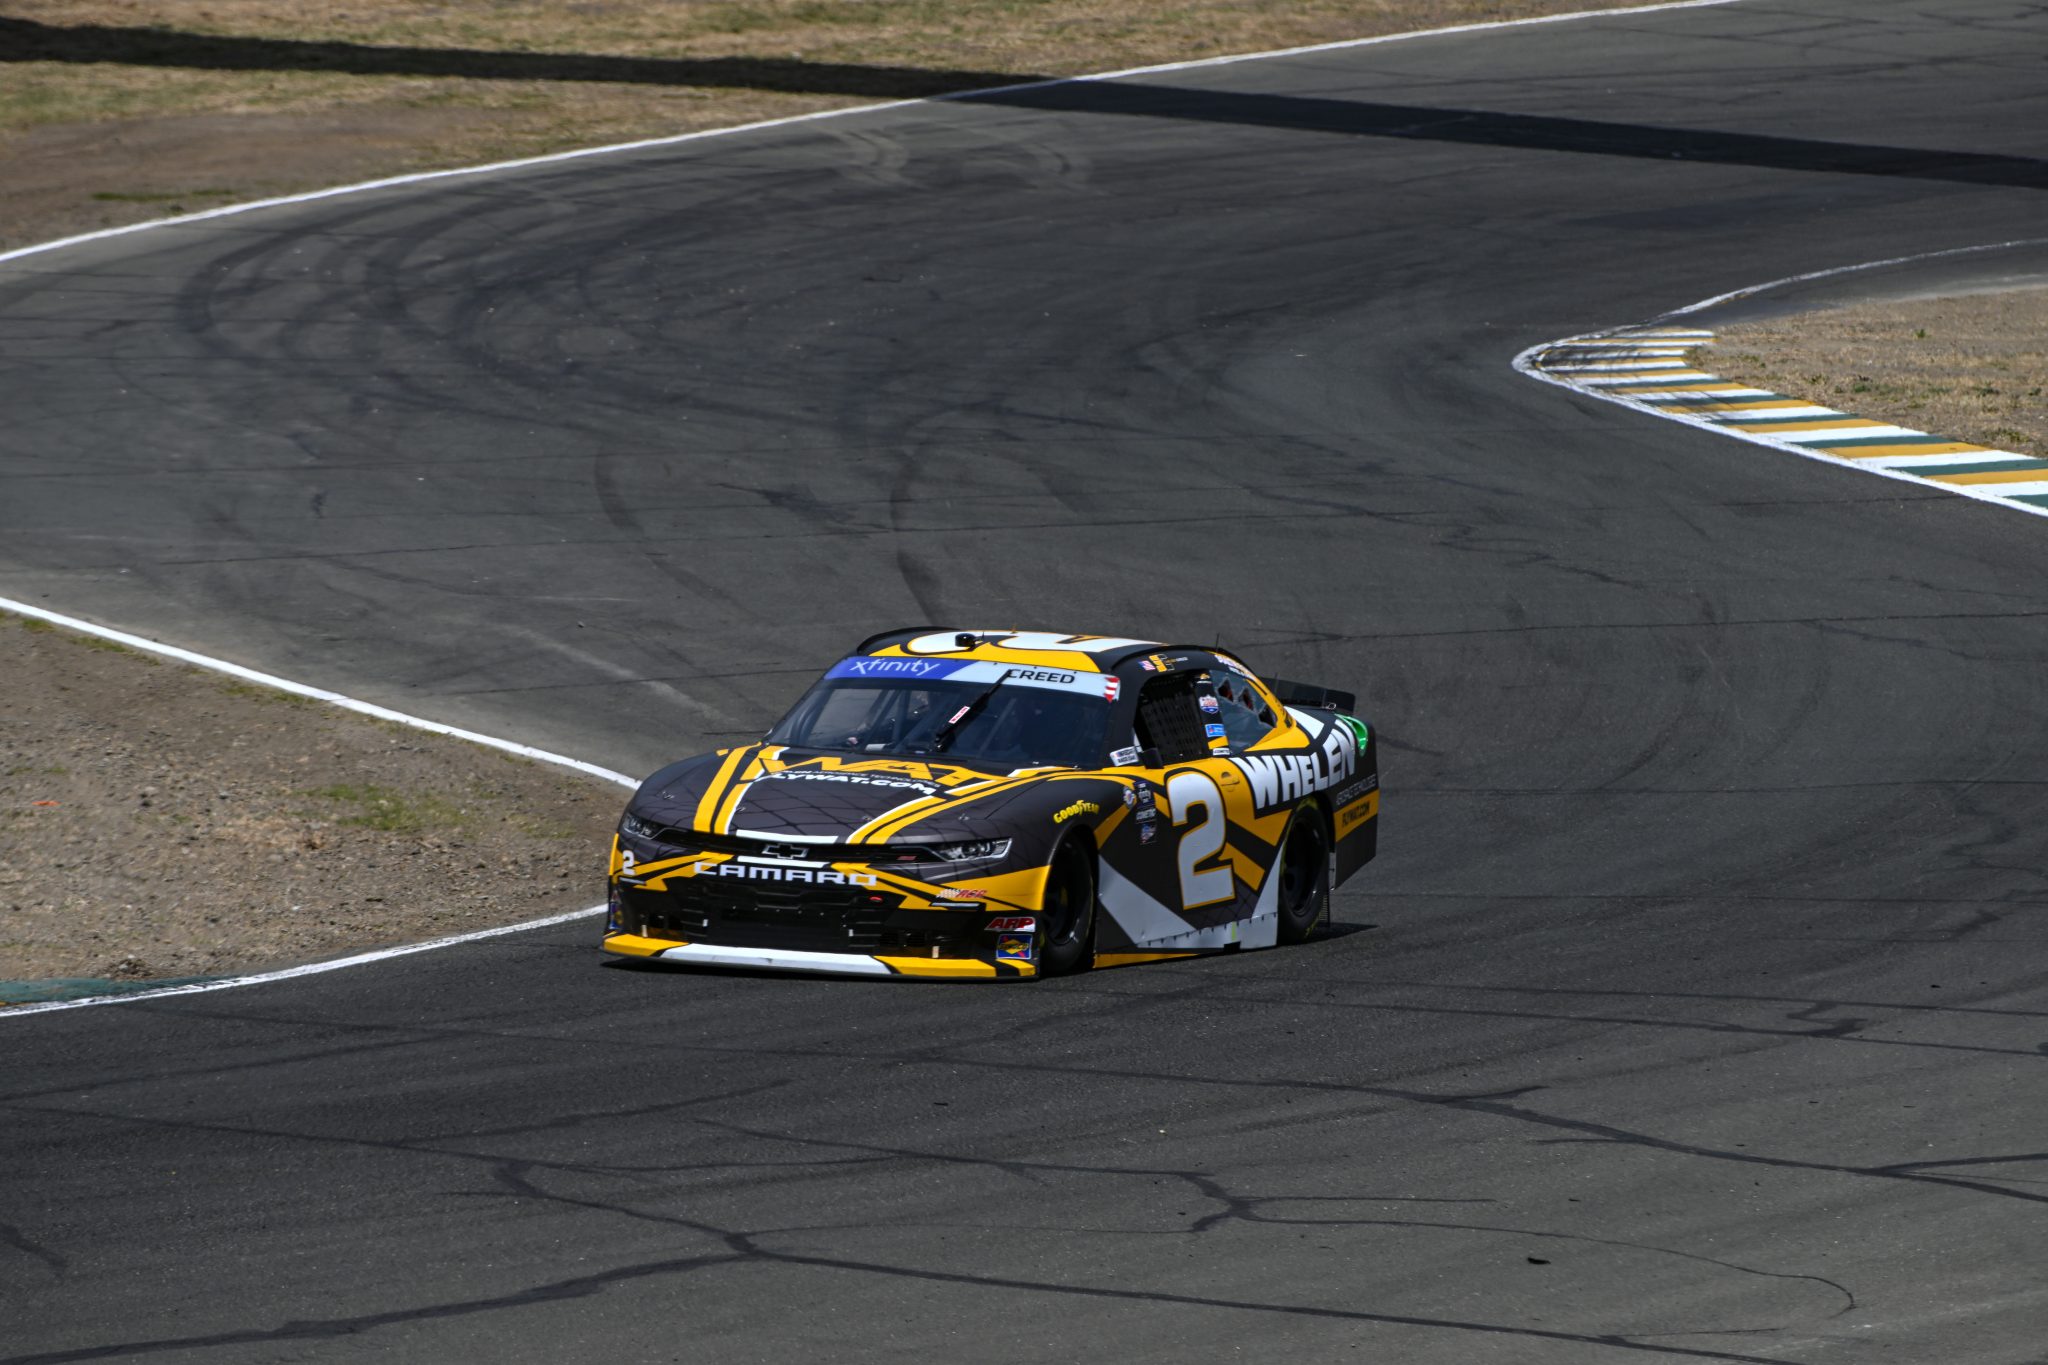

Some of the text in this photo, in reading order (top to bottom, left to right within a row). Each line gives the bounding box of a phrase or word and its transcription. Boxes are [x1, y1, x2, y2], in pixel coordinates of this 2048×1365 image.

[849, 658, 941, 677] xfinity
[1007, 667, 1076, 685] CREED
[1228, 719, 1356, 810] WHELEN
[1053, 799, 1099, 823] GOODYEAR
[1166, 770, 1236, 911] 2
[622, 850, 636, 876] 2
[693, 861, 877, 887] CAMARO
[987, 917, 1034, 930] ARP
